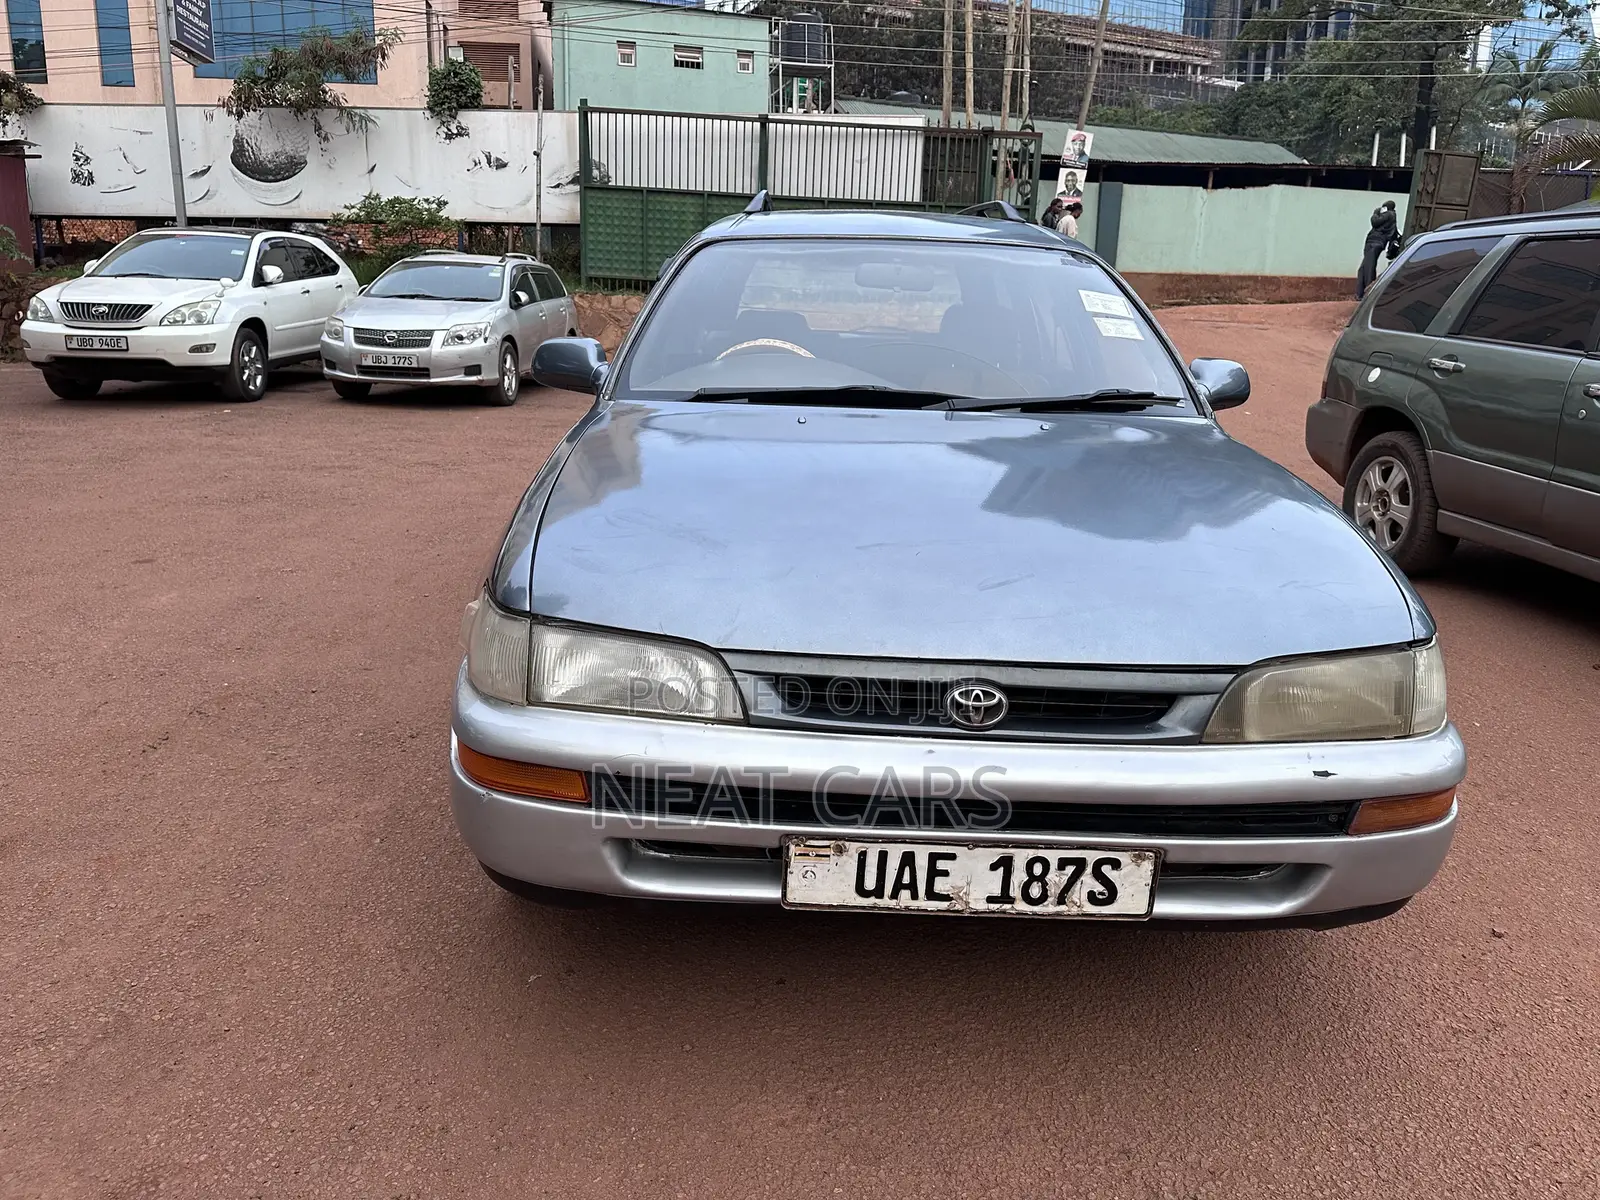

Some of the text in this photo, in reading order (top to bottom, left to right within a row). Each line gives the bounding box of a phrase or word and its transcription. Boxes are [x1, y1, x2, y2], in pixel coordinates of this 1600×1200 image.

[176, 4, 209, 32] RESTAURANT
[76, 337, 123, 349] UBQ 940E
[371, 354, 413, 366] UBJ 177S
[854, 848, 1123, 907] UAE 187S
